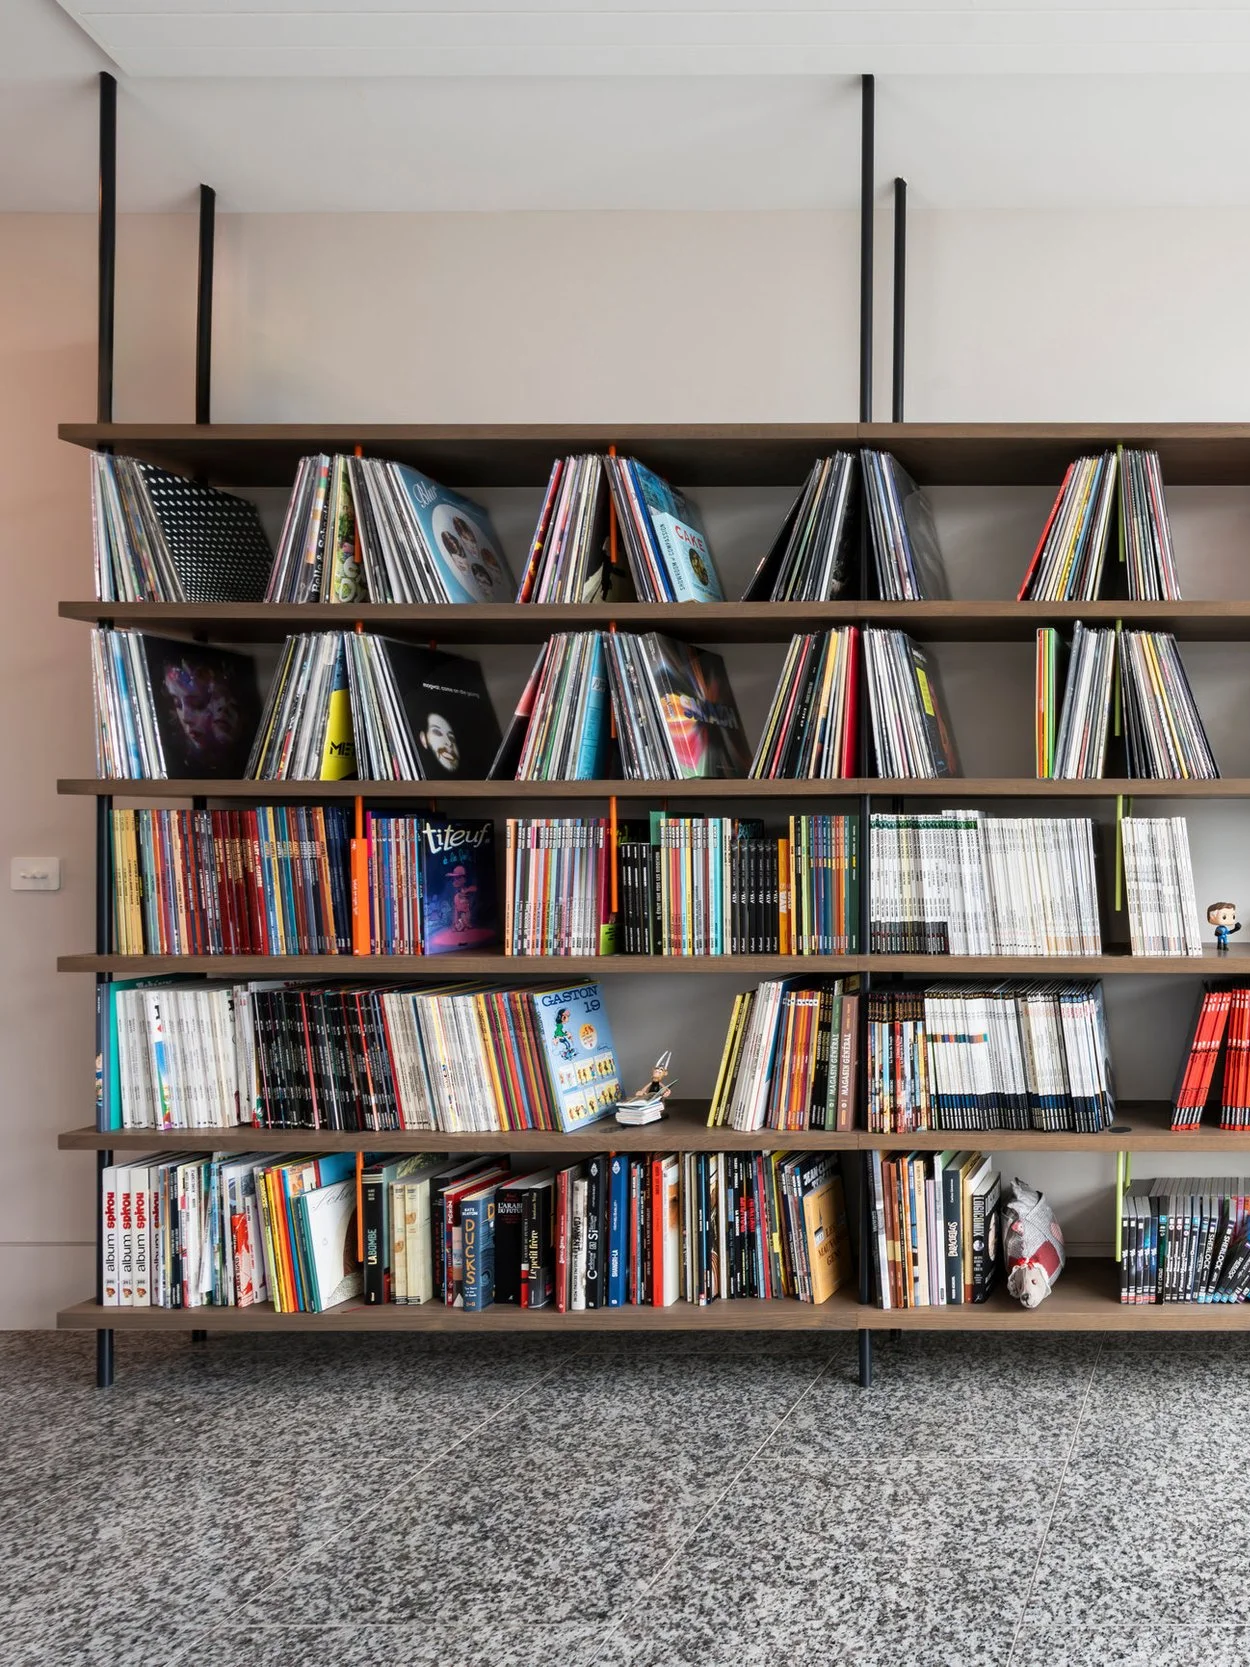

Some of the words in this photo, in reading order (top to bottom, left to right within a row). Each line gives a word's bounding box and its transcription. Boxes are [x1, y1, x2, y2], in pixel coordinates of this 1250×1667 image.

[412, 481, 438, 509] Blur
[675, 525, 705, 553] CAKE
[422, 822, 491, 854] titeuf
[542, 985, 597, 1007] GASTON
[584, 1000, 601, 1013] 19
[830, 1033, 840, 1064] GÉNÉRAL
[842, 1033, 852, 1064] GÉNÉRAL
[829, 1064, 838, 1096] MAGASIN
[841, 1064, 850, 1096] MAGASIN
[104, 1192, 116, 1229] spirou
[120, 1193, 132, 1232] spirou
[134, 1192, 146, 1230] spirou
[973, 1196, 985, 1236] LOGICOMIX
[105, 1233, 114, 1272] album
[121, 1234, 132, 1273] album
[136, 1233, 146, 1273] album
[464, 1218, 477, 1285] DUCKS
[611, 1249, 619, 1278] SHANGRI-LA
[1203, 1234, 1216, 1270] SHERLOCK
[1214, 1235, 1231, 1270] SHERLOCK
